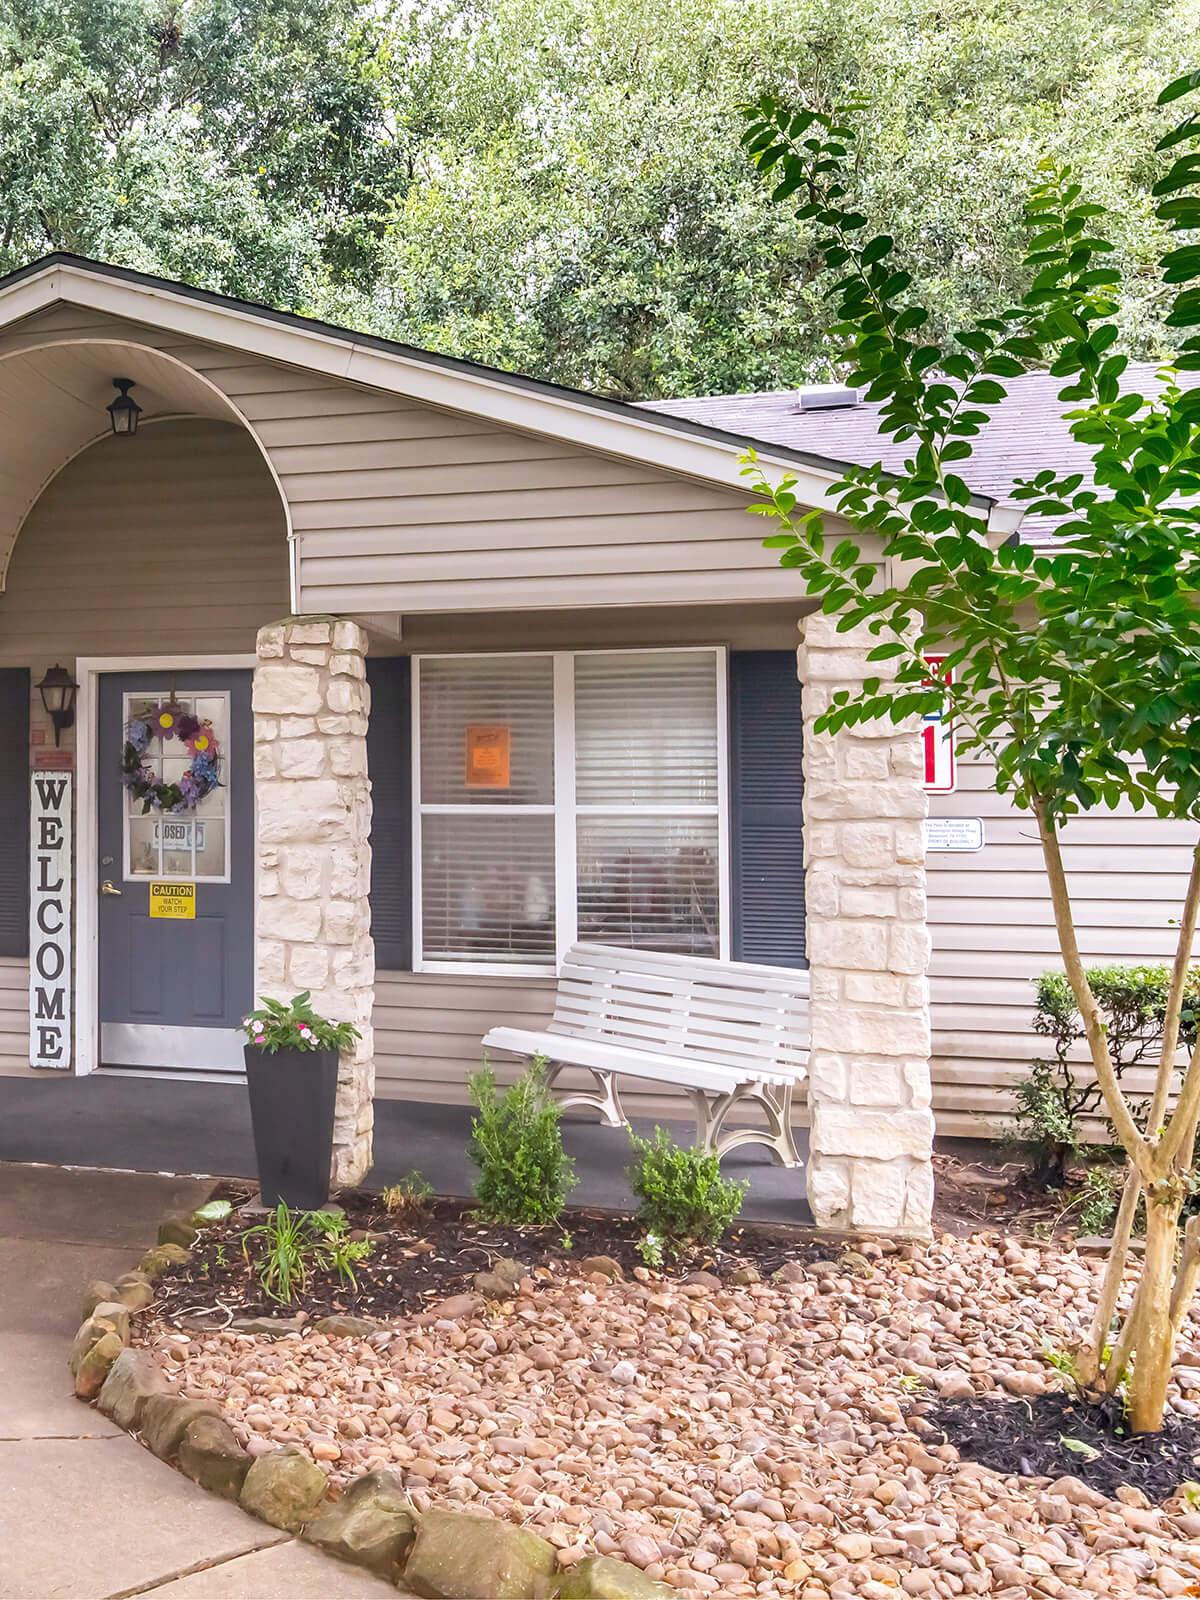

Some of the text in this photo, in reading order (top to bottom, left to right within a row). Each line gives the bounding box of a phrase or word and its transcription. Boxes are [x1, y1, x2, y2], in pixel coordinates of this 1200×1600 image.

[154, 824, 185, 840] COSED
[153, 886, 192, 896] CAUTION
[158, 905, 188, 913] YOUR STEP
[34, 779, 67, 1060] WELCOME
